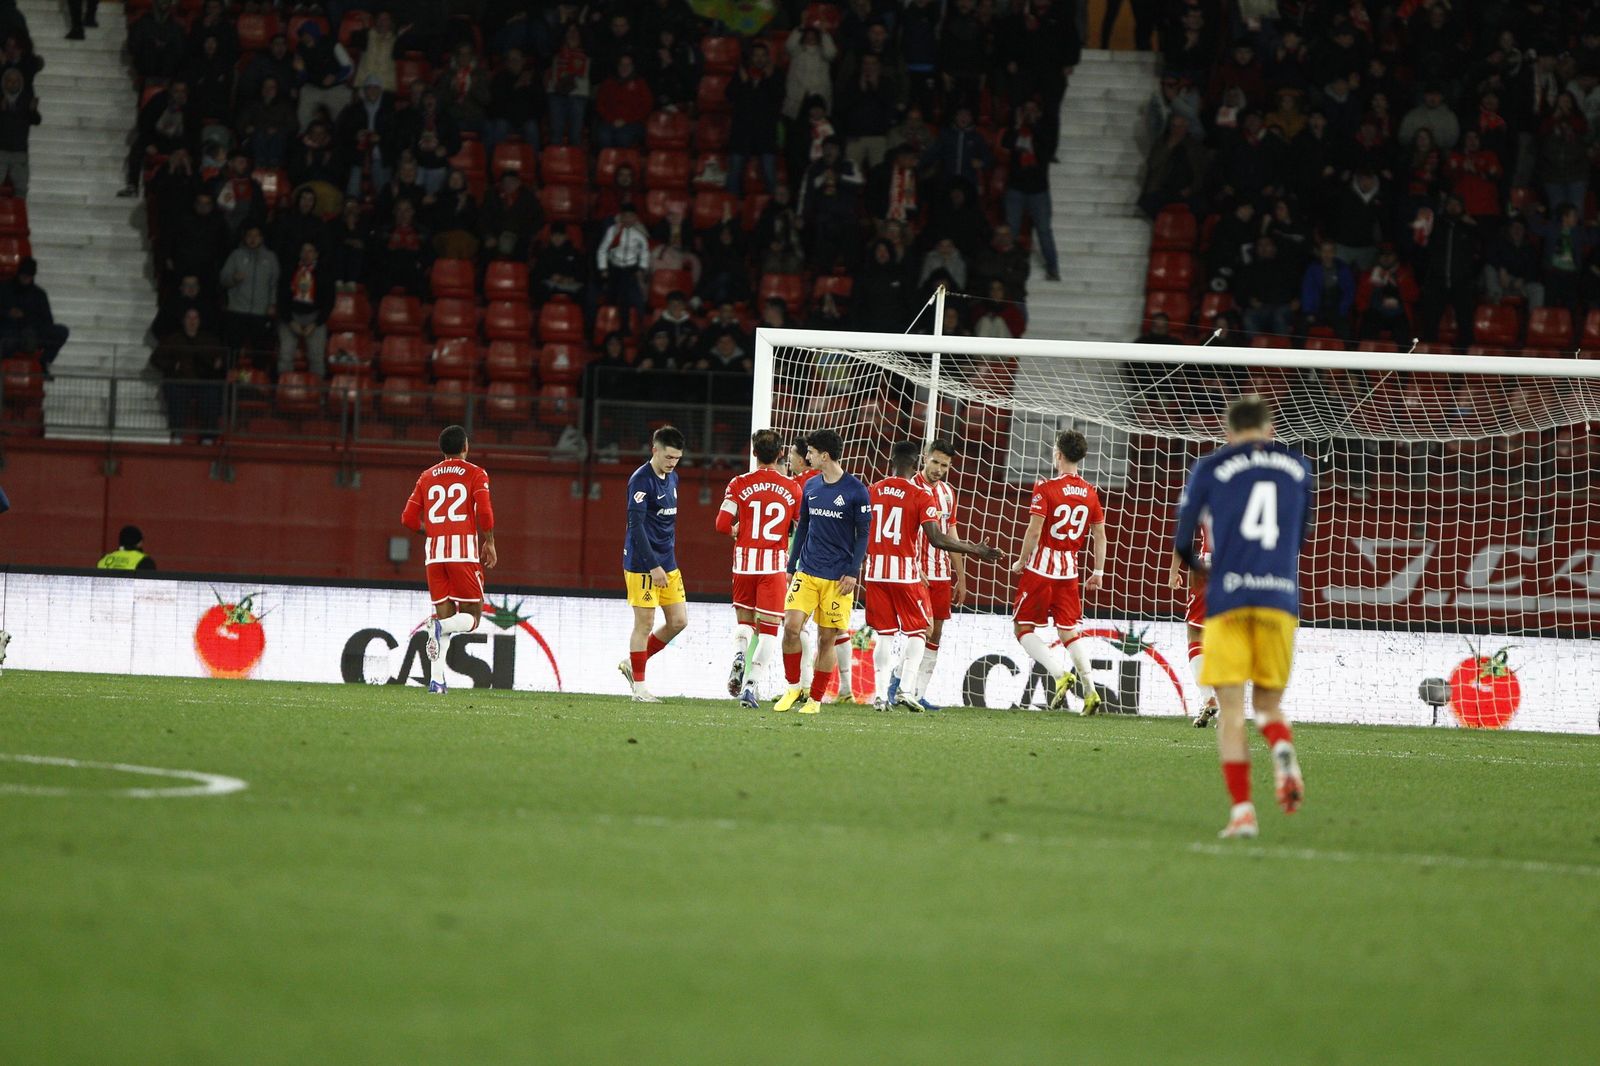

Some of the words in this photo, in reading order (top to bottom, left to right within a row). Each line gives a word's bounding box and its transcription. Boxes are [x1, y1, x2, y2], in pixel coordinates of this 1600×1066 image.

[432, 466, 466, 477] CHIRINO
[428, 482, 467, 524] 22
[738, 486, 754, 501] LEO
[752, 482, 796, 506] BAPTISTAO
[877, 486, 906, 500] I.BABA
[748, 500, 786, 541] 12
[872, 503, 903, 545] 14
[1050, 504, 1089, 541] 29
[1240, 481, 1279, 550] 4
[641, 574, 653, 590] 11
[341, 627, 516, 689] CASI
